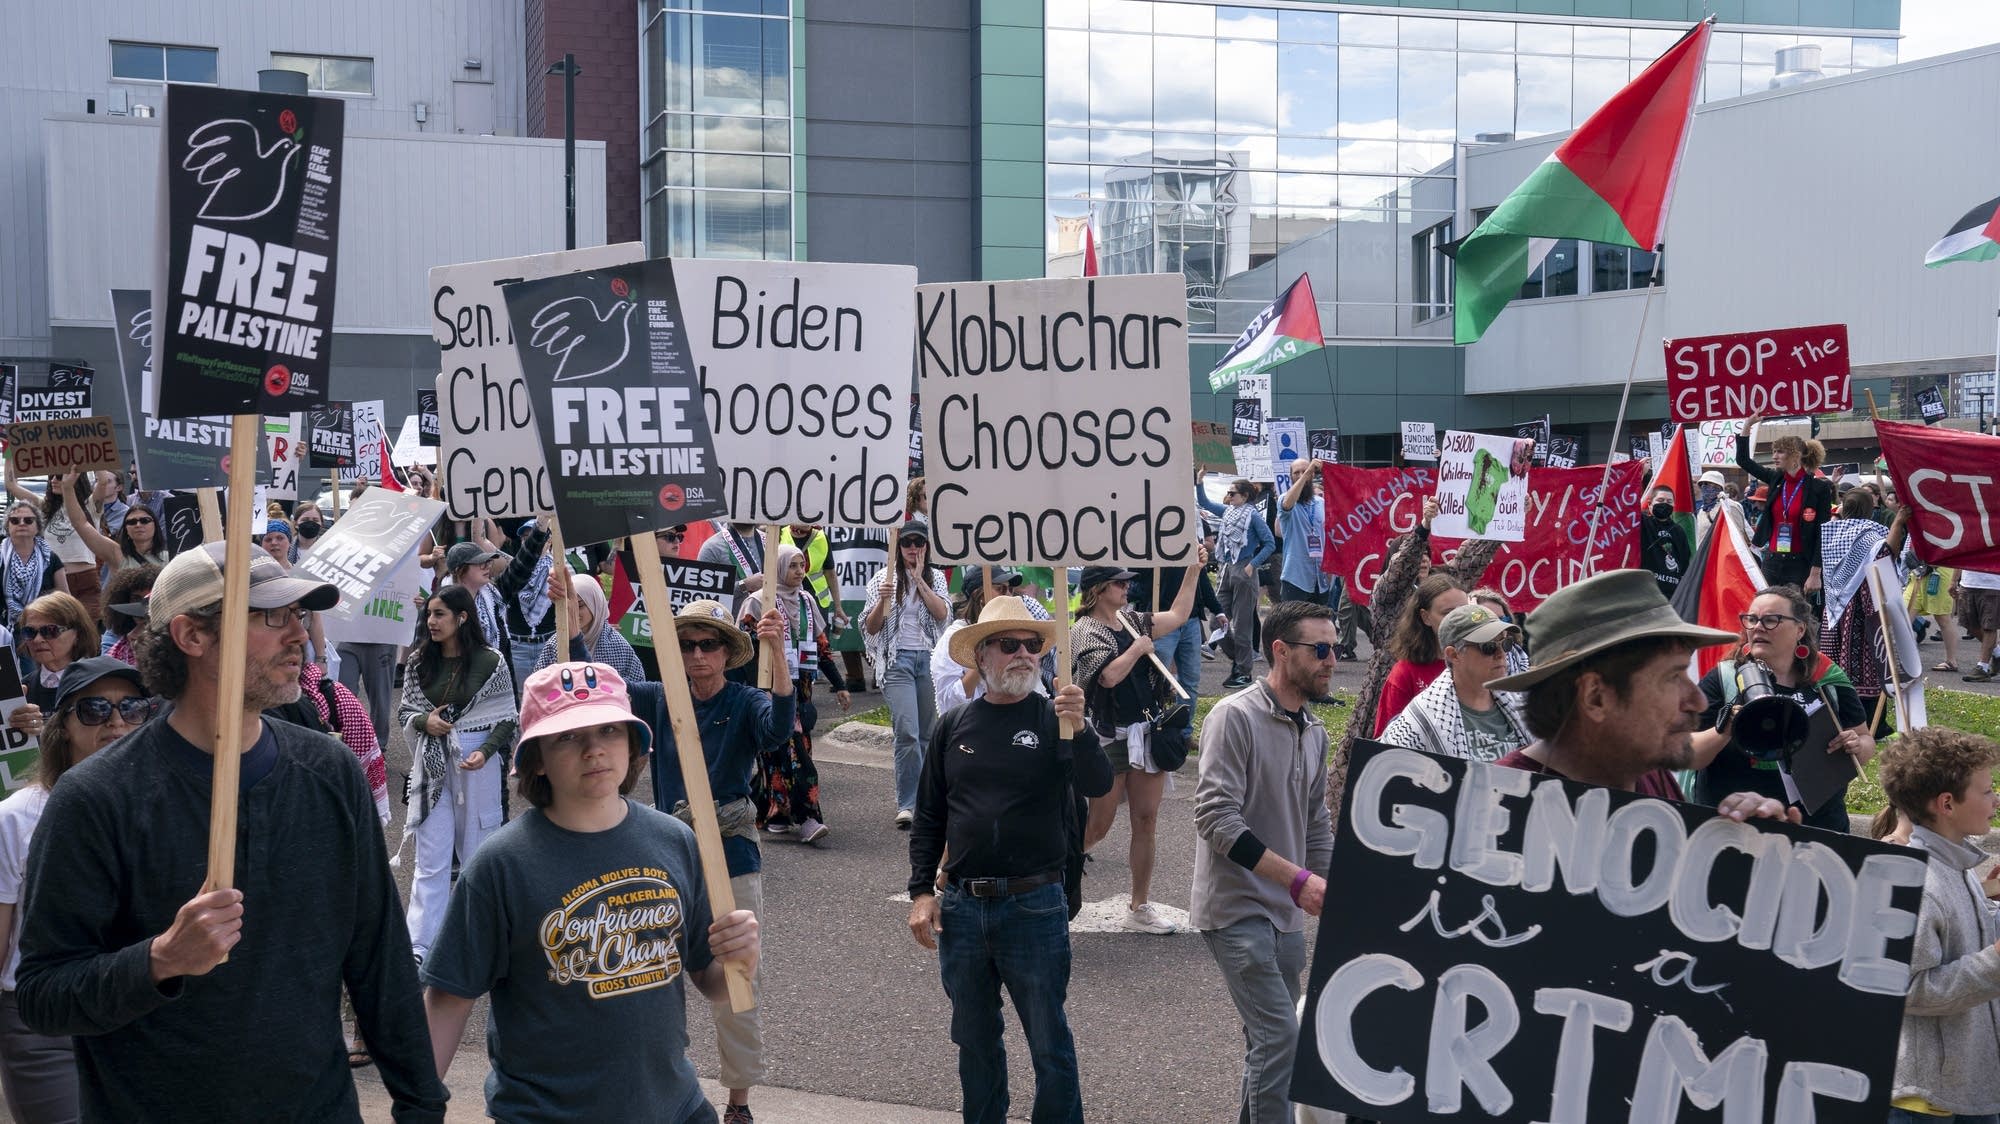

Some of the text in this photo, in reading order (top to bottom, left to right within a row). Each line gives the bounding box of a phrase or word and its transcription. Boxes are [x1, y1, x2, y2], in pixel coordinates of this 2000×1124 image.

[181, 224, 328, 322] FREE
[434, 285, 500, 351] Sen.
[712, 275, 863, 352] Biden
[178, 301, 323, 360] PALESTINE
[917, 280, 1182, 378] Klobuchar
[1674, 337, 1840, 381] STOP the
[291, 372, 310, 388] DSA
[21, 391, 86, 408] DIVEST
[1675, 374, 1851, 420] GENOCIDE!
[1921, 402, 1943, 415] FREE
[21, 410, 82, 421] MN FROM
[551, 387, 694, 445] FREE
[1234, 417, 1260, 431] FREE
[1408, 423, 1426, 433] STOP
[48, 421, 110, 441] FUNDING
[312, 428, 352, 449] FREE
[938, 393, 1172, 472] Chooses
[1404, 435, 1435, 444] FUNDING
[14, 441, 116, 473] GENOCIDE
[312, 443, 353, 457] PALESTINE
[560, 447, 706, 476] PALESTINE
[1312, 448, 1338, 462] FREE
[1404, 445, 1435, 455] GENOCIDE
[1548, 453, 1577, 470] FREE
[1441, 459, 1473, 483] Children
[686, 487, 705, 499] DSA
[1439, 491, 1465, 516] Killed
[1499, 502, 1518, 514] OUR
[931, 479, 1192, 562] Genocide
[1328, 468, 1435, 552] KLOBUCHAR
[1567, 483, 1638, 545] CRAIG
[1594, 511, 1641, 550] WALZ
[313, 531, 395, 584] FREE
[300, 555, 372, 600] PALESTINE
[670, 589, 720, 603] FROM
[561, 867, 669, 907] ALGOMA WOLVES BOYS
[1351, 748, 1928, 996] GENOCIDE
[607, 888, 678, 908] PACKERLAND
[1399, 875, 1543, 948] is
[540, 901, 679, 953] Conference
[593, 976, 626, 994] CROSS
[627, 966, 666, 987] COUNTRY
[1633, 949, 1734, 1005] a
